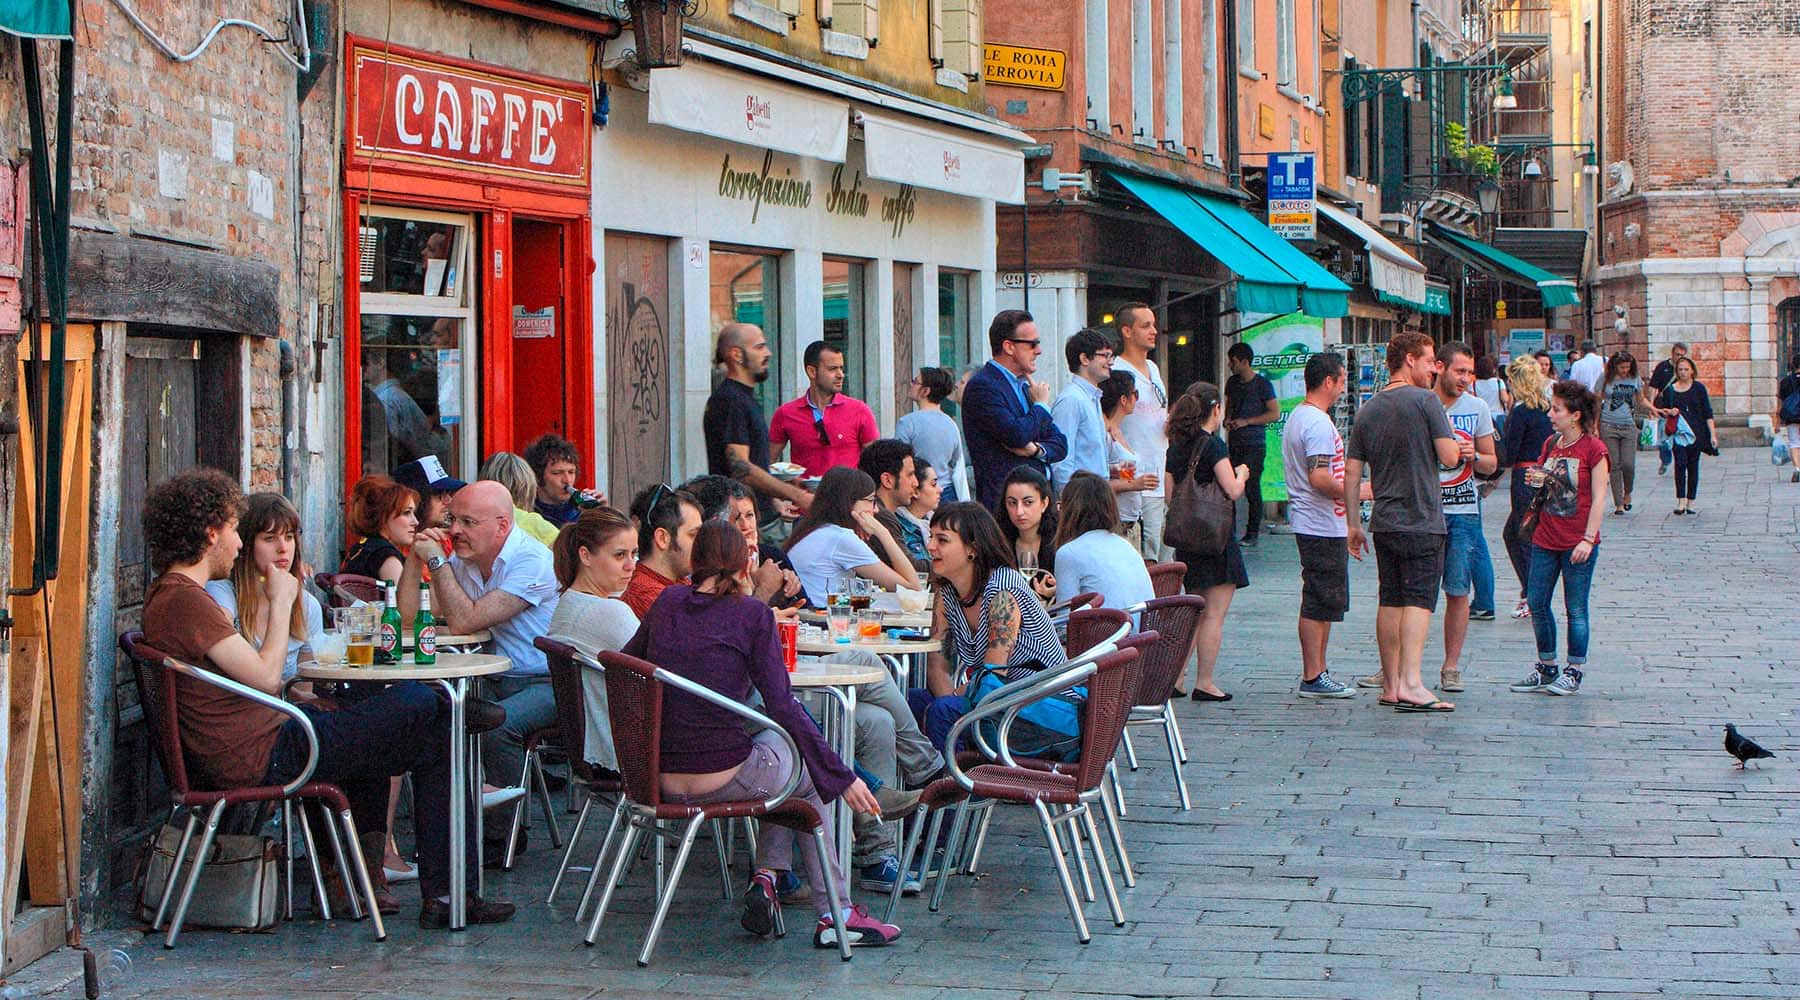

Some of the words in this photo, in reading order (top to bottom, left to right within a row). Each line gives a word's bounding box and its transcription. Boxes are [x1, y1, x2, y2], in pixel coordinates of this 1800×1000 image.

[1013, 52, 1056, 67] ROMA
[984, 65, 1056, 83] ERROVIA
[1277, 156, 1305, 186] T
[826, 163, 869, 218] India
[1005, 274, 1037, 285] 297
